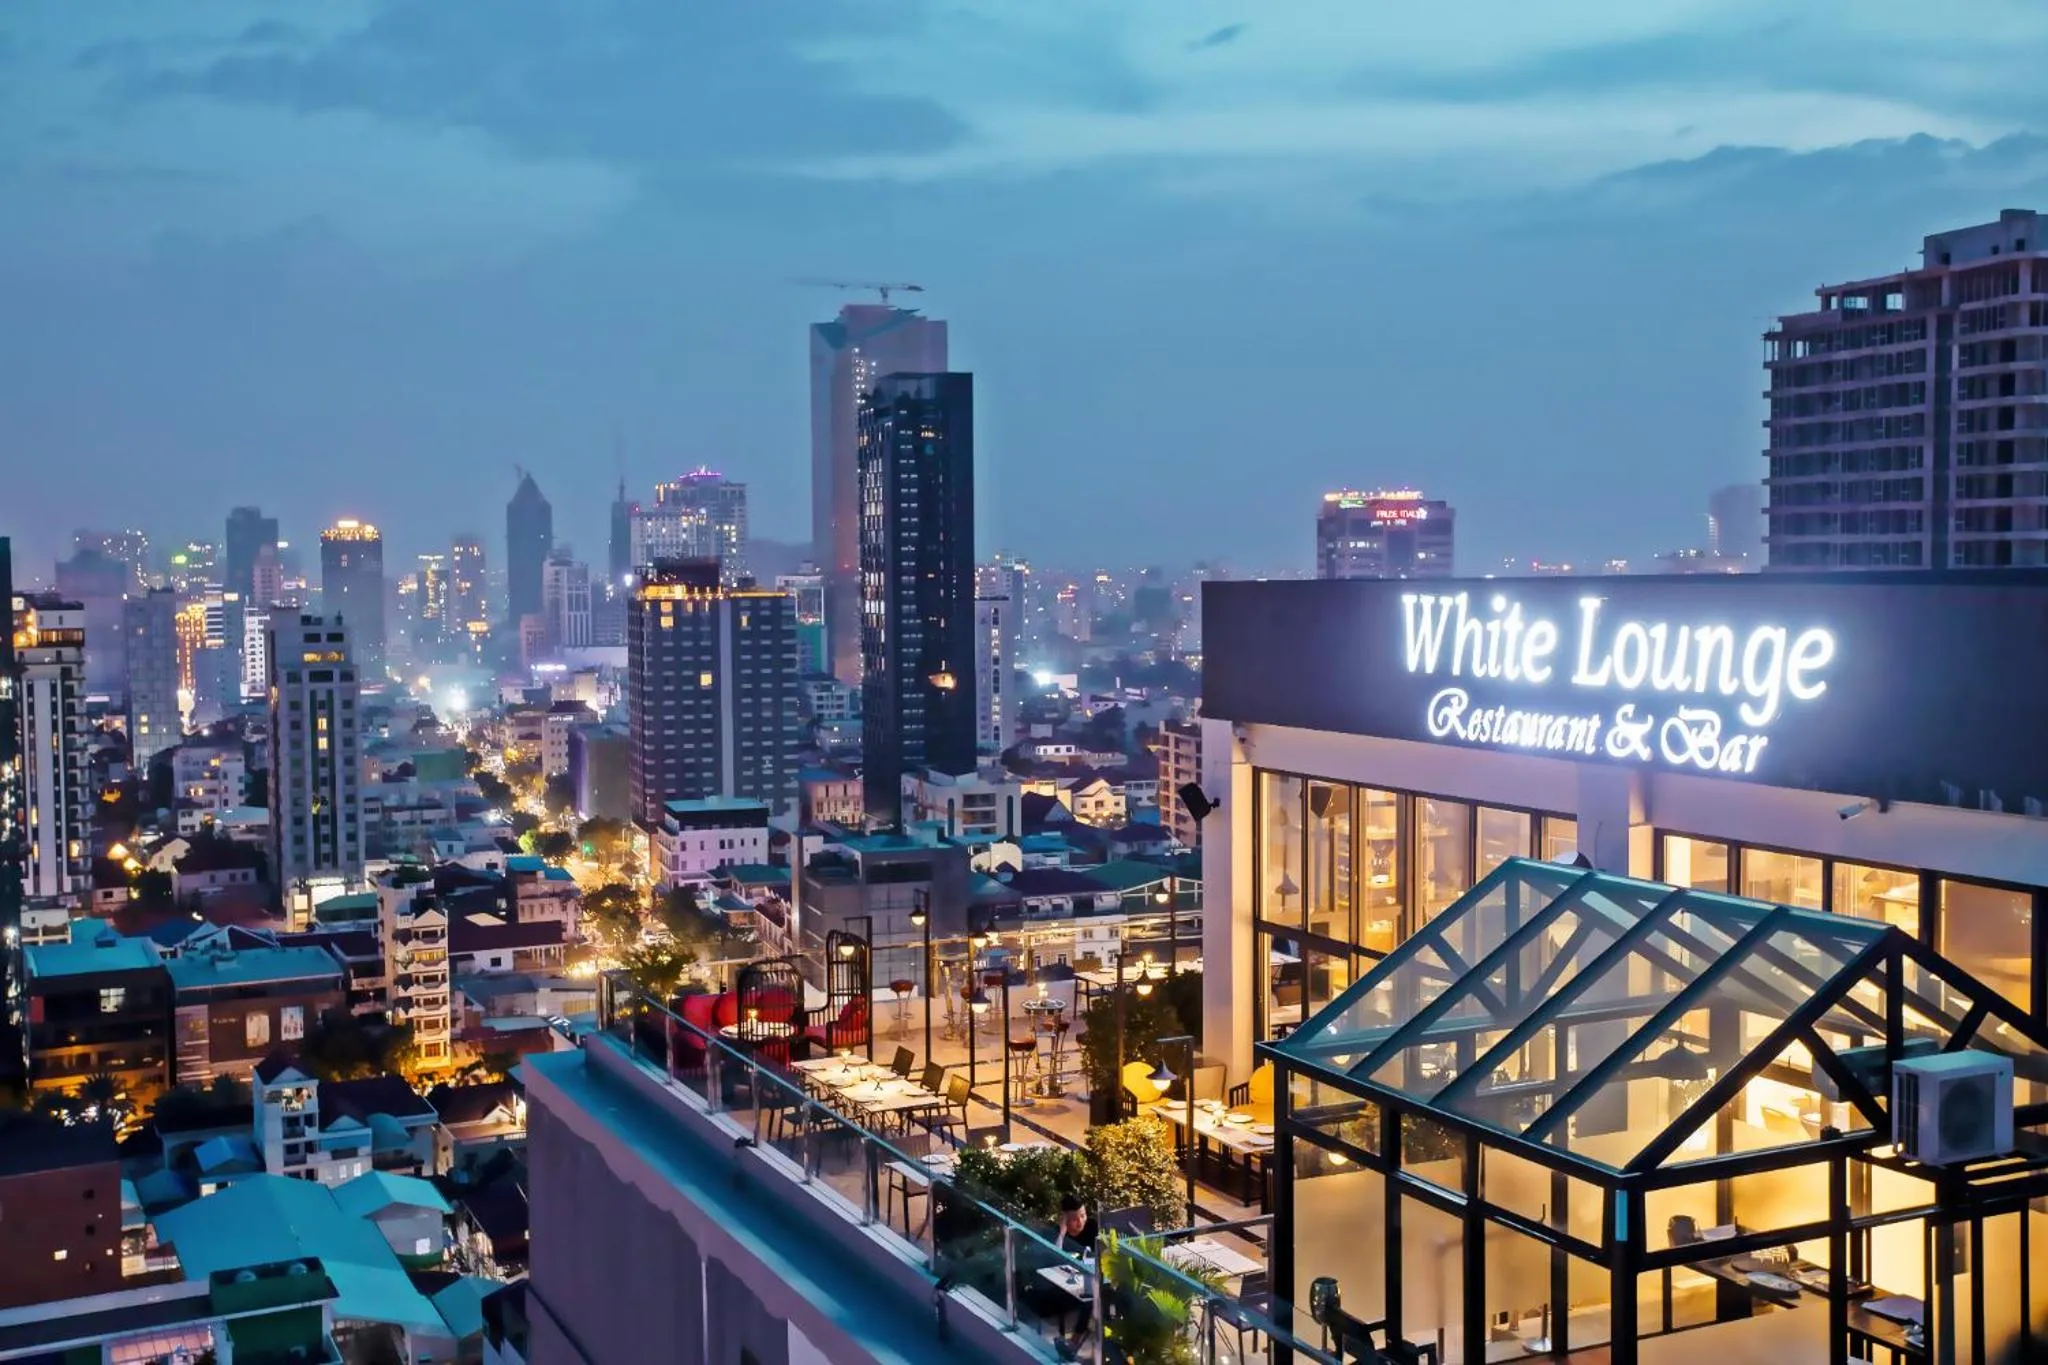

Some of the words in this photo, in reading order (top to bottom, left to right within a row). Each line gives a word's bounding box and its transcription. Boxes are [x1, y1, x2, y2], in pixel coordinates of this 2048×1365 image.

[1401, 592, 1557, 683] White
[1572, 596, 1835, 725] Lounge
[1427, 687, 1600, 755] Restaurant
[1606, 703, 1653, 760] &
[1660, 705, 1768, 772] Bar
